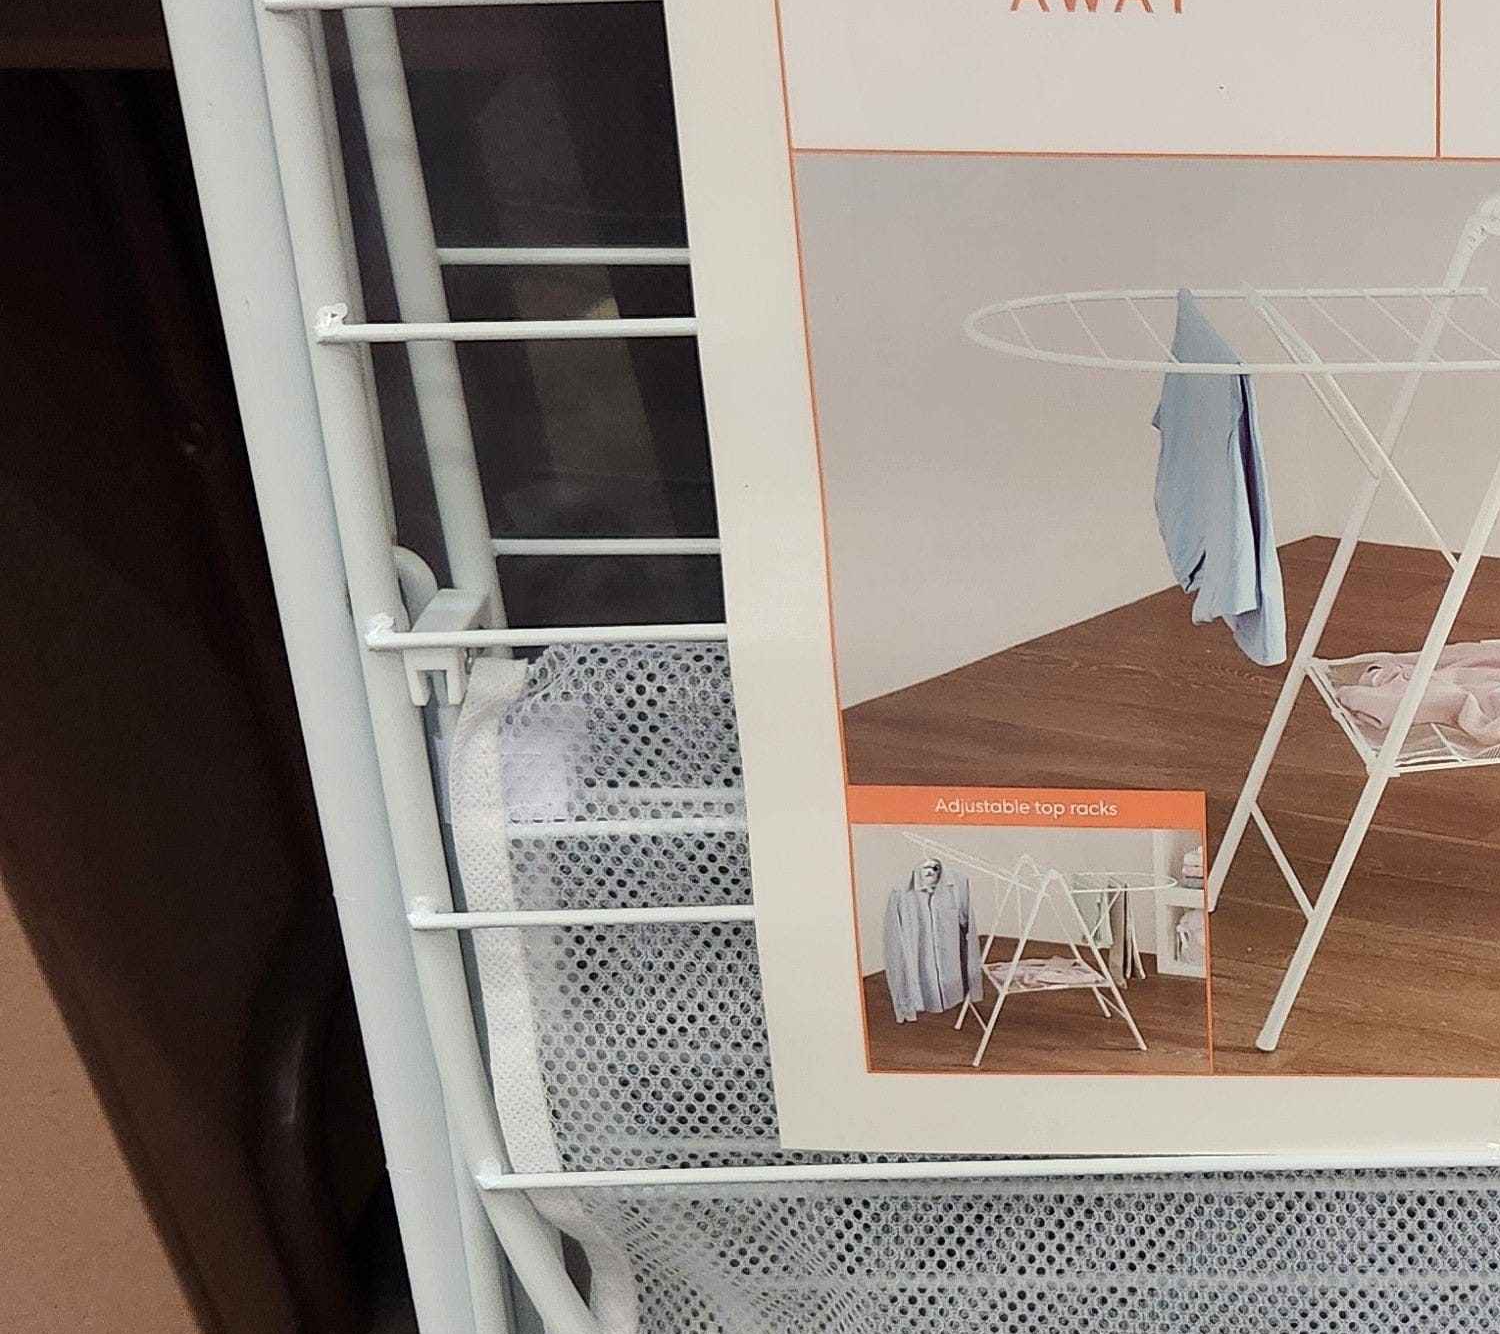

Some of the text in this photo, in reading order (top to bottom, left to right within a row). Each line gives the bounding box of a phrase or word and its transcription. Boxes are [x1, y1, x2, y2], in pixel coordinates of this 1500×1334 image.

[934, 797, 1118, 818] Adjustable top racks
